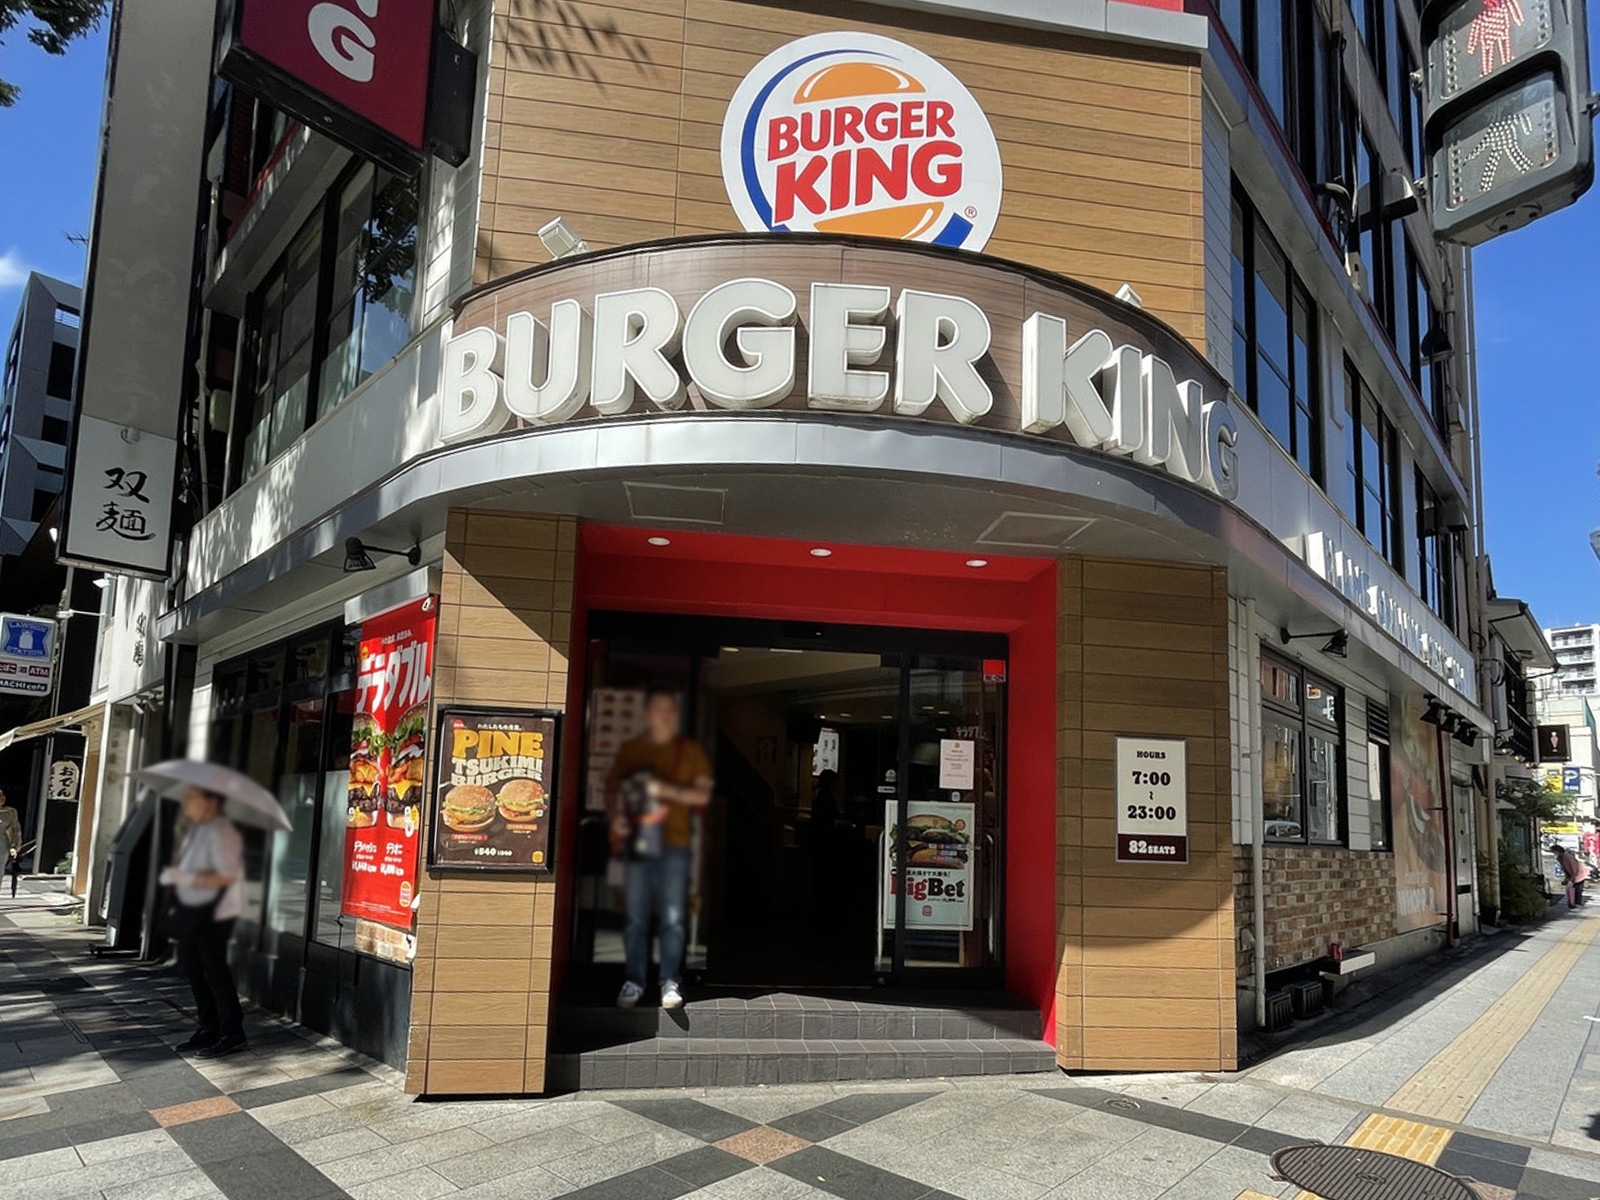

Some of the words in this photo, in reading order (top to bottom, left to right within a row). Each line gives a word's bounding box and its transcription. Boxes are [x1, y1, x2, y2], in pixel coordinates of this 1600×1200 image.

[308, 0, 379, 83] G
[768, 100, 956, 162] BURGER
[773, 140, 965, 224] KING
[439, 277, 994, 446] BURGER
[1020, 309, 1240, 501] KING
[96, 467, 156, 541] 双麺
[29, 667, 49, 676] ATM
[452, 729, 544, 759] PINE
[1136, 750, 1166, 760] HOURS
[451, 755, 544, 776] TSUKIMI
[451, 768, 543, 787] BURGER
[1132, 771, 1171, 786] 7:00
[57, 766, 75, 798] おでん
[1127, 805, 1176, 820] 23:00
